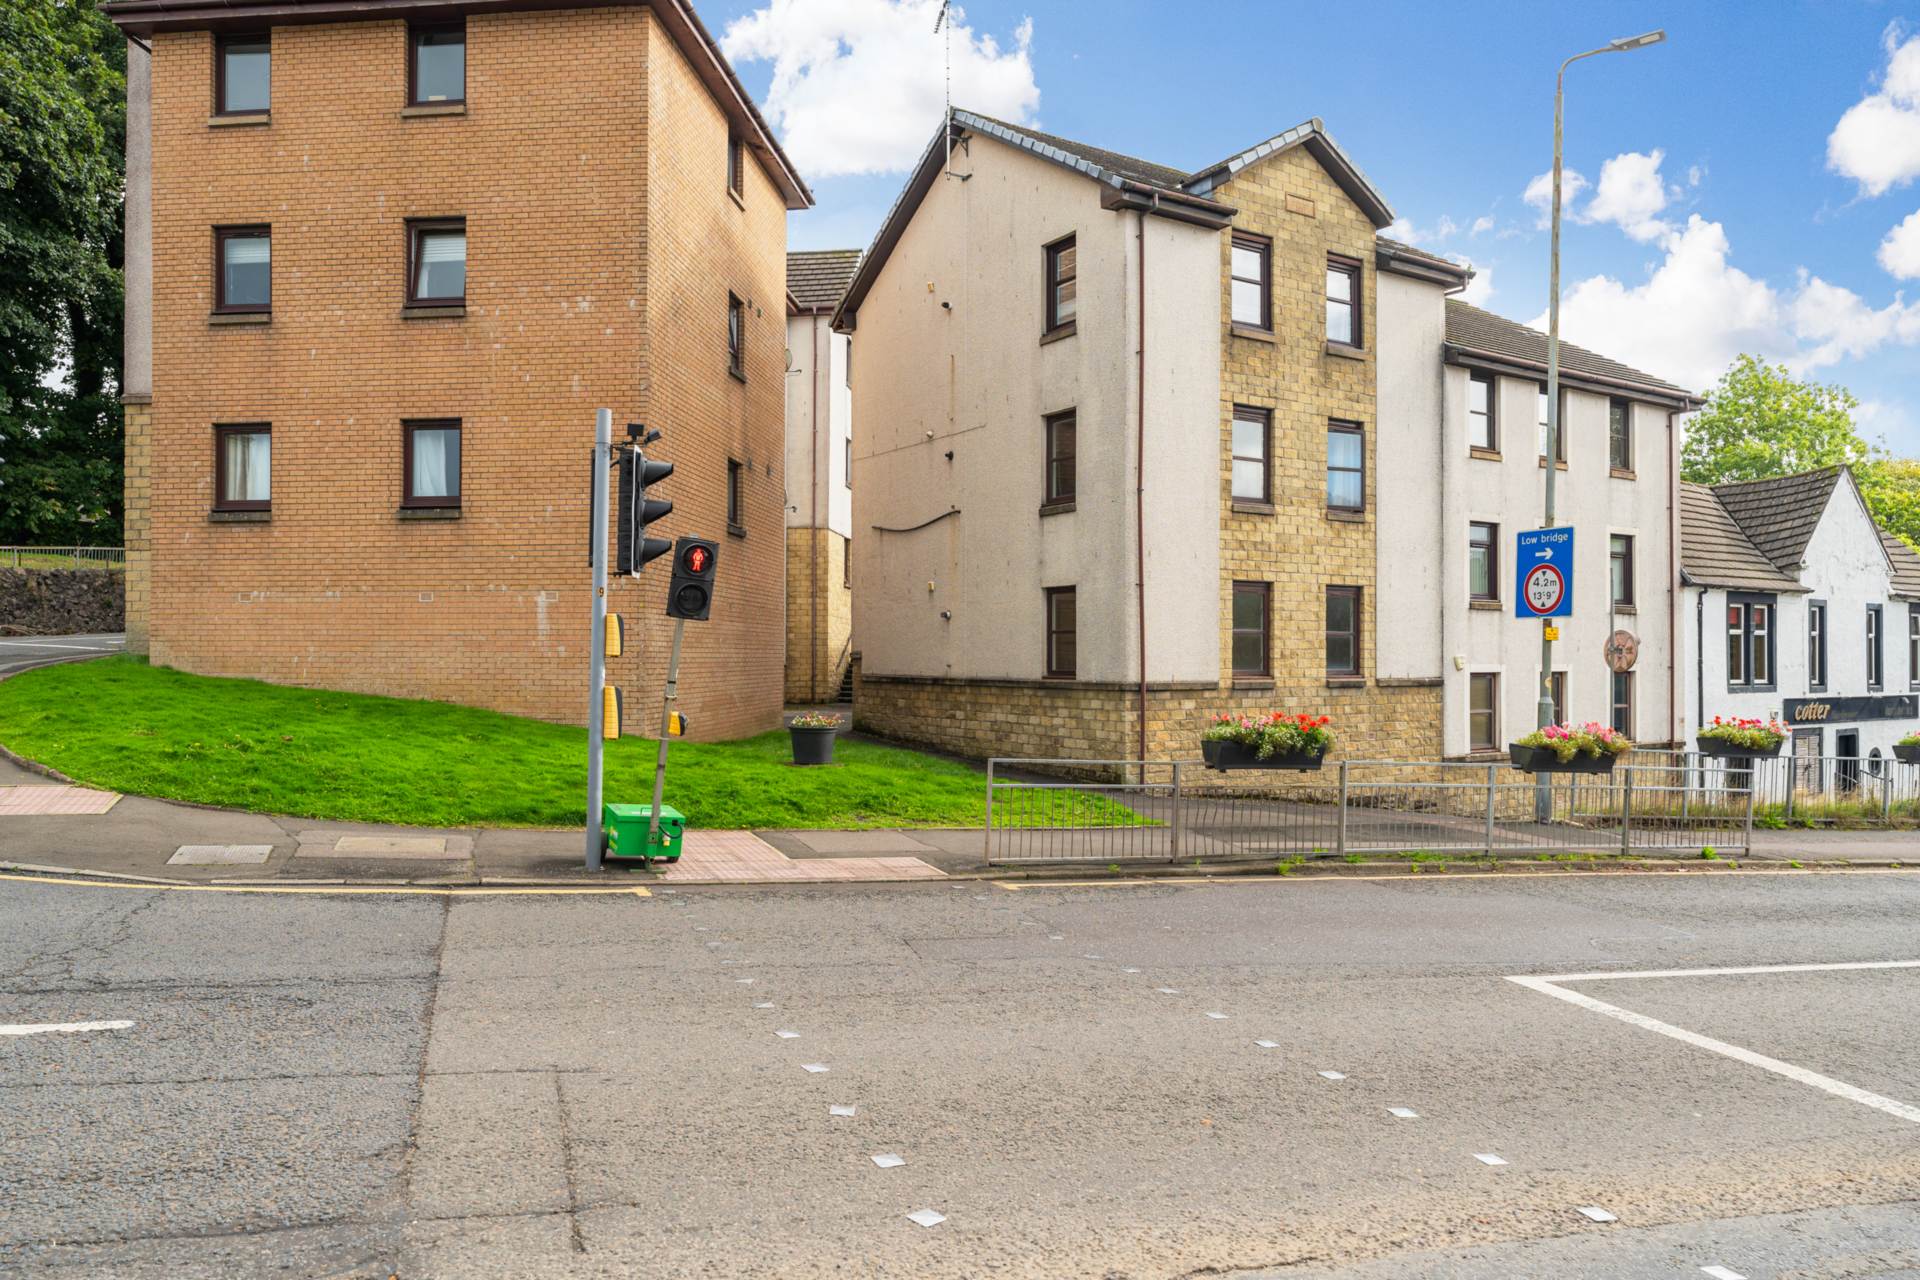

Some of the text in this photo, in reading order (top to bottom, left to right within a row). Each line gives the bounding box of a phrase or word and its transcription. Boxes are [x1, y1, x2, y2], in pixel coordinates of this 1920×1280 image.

[1521, 532, 1569, 545] Low bridge
[1533, 577, 1557, 587] 4.2m
[1795, 701, 1831, 721] cotter
